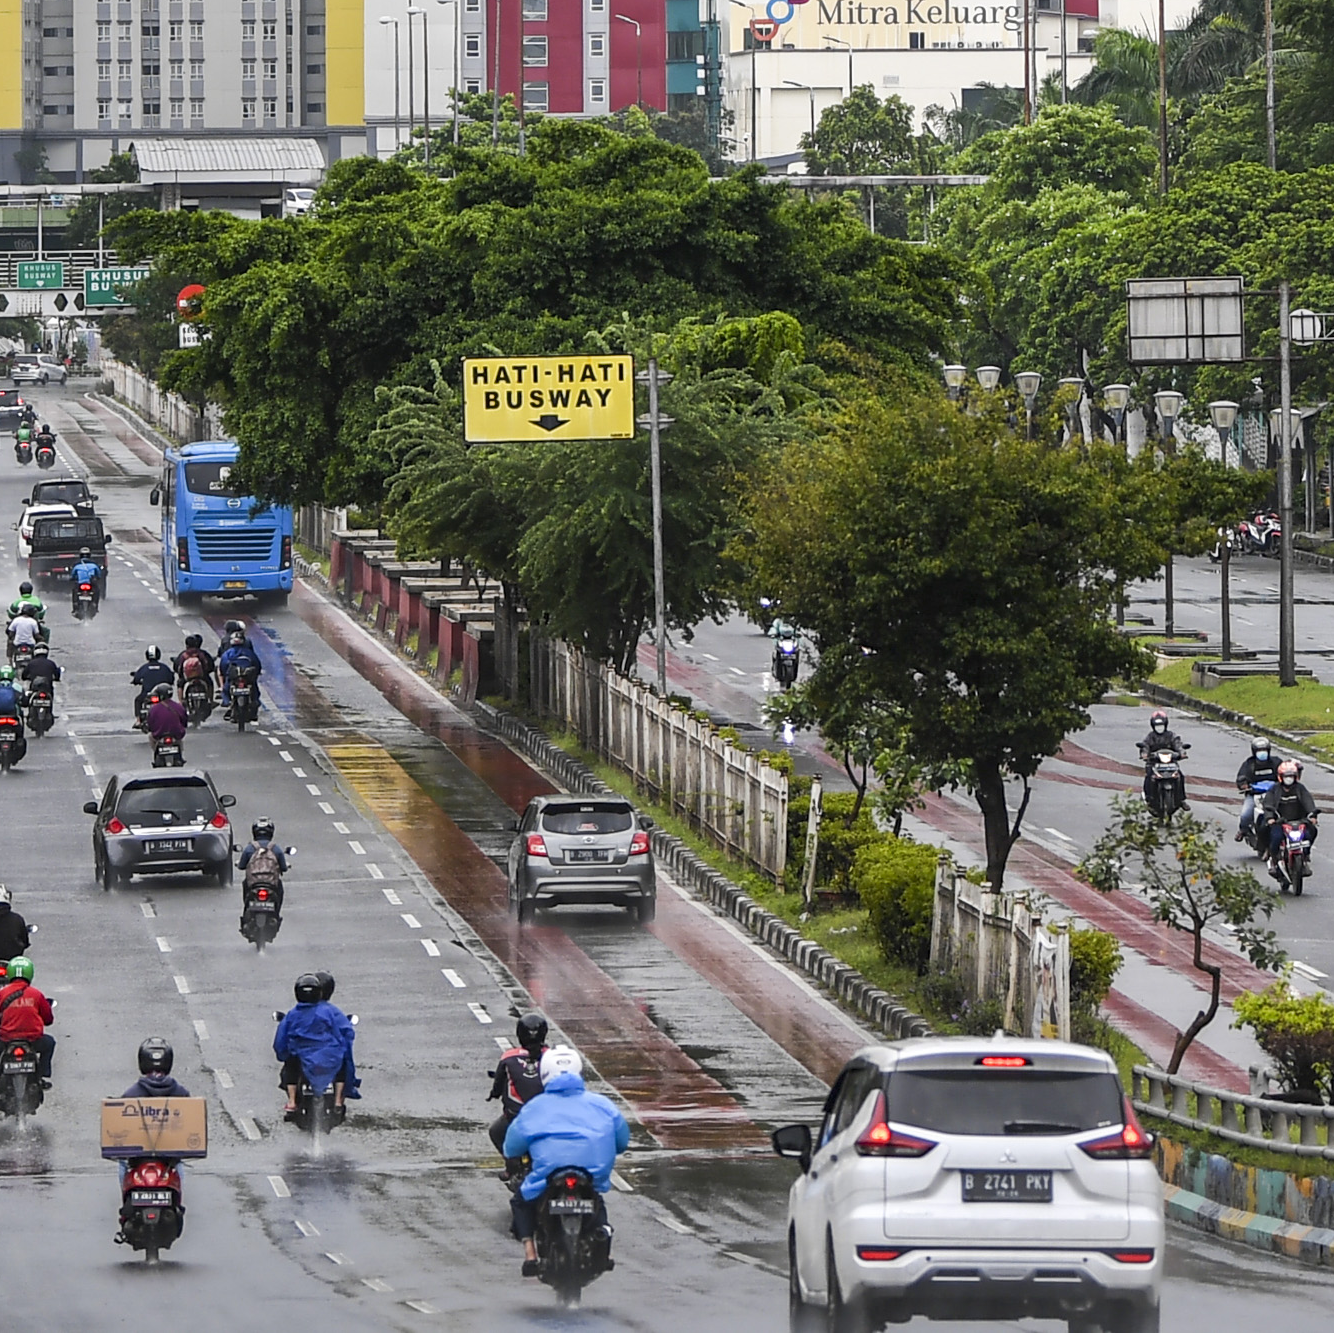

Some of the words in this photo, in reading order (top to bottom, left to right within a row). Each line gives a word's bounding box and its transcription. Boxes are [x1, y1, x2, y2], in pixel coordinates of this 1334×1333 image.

[91, 271, 151, 281] KHUSUS
[472, 362, 624, 385] HATI-HATI
[484, 388, 612, 410] BUSWAY
[140, 1106, 170, 1117] libra
[965, 1174, 974, 1190] B
[984, 1174, 1015, 1190] 2741
[1026, 1174, 1050, 1190] PKY
